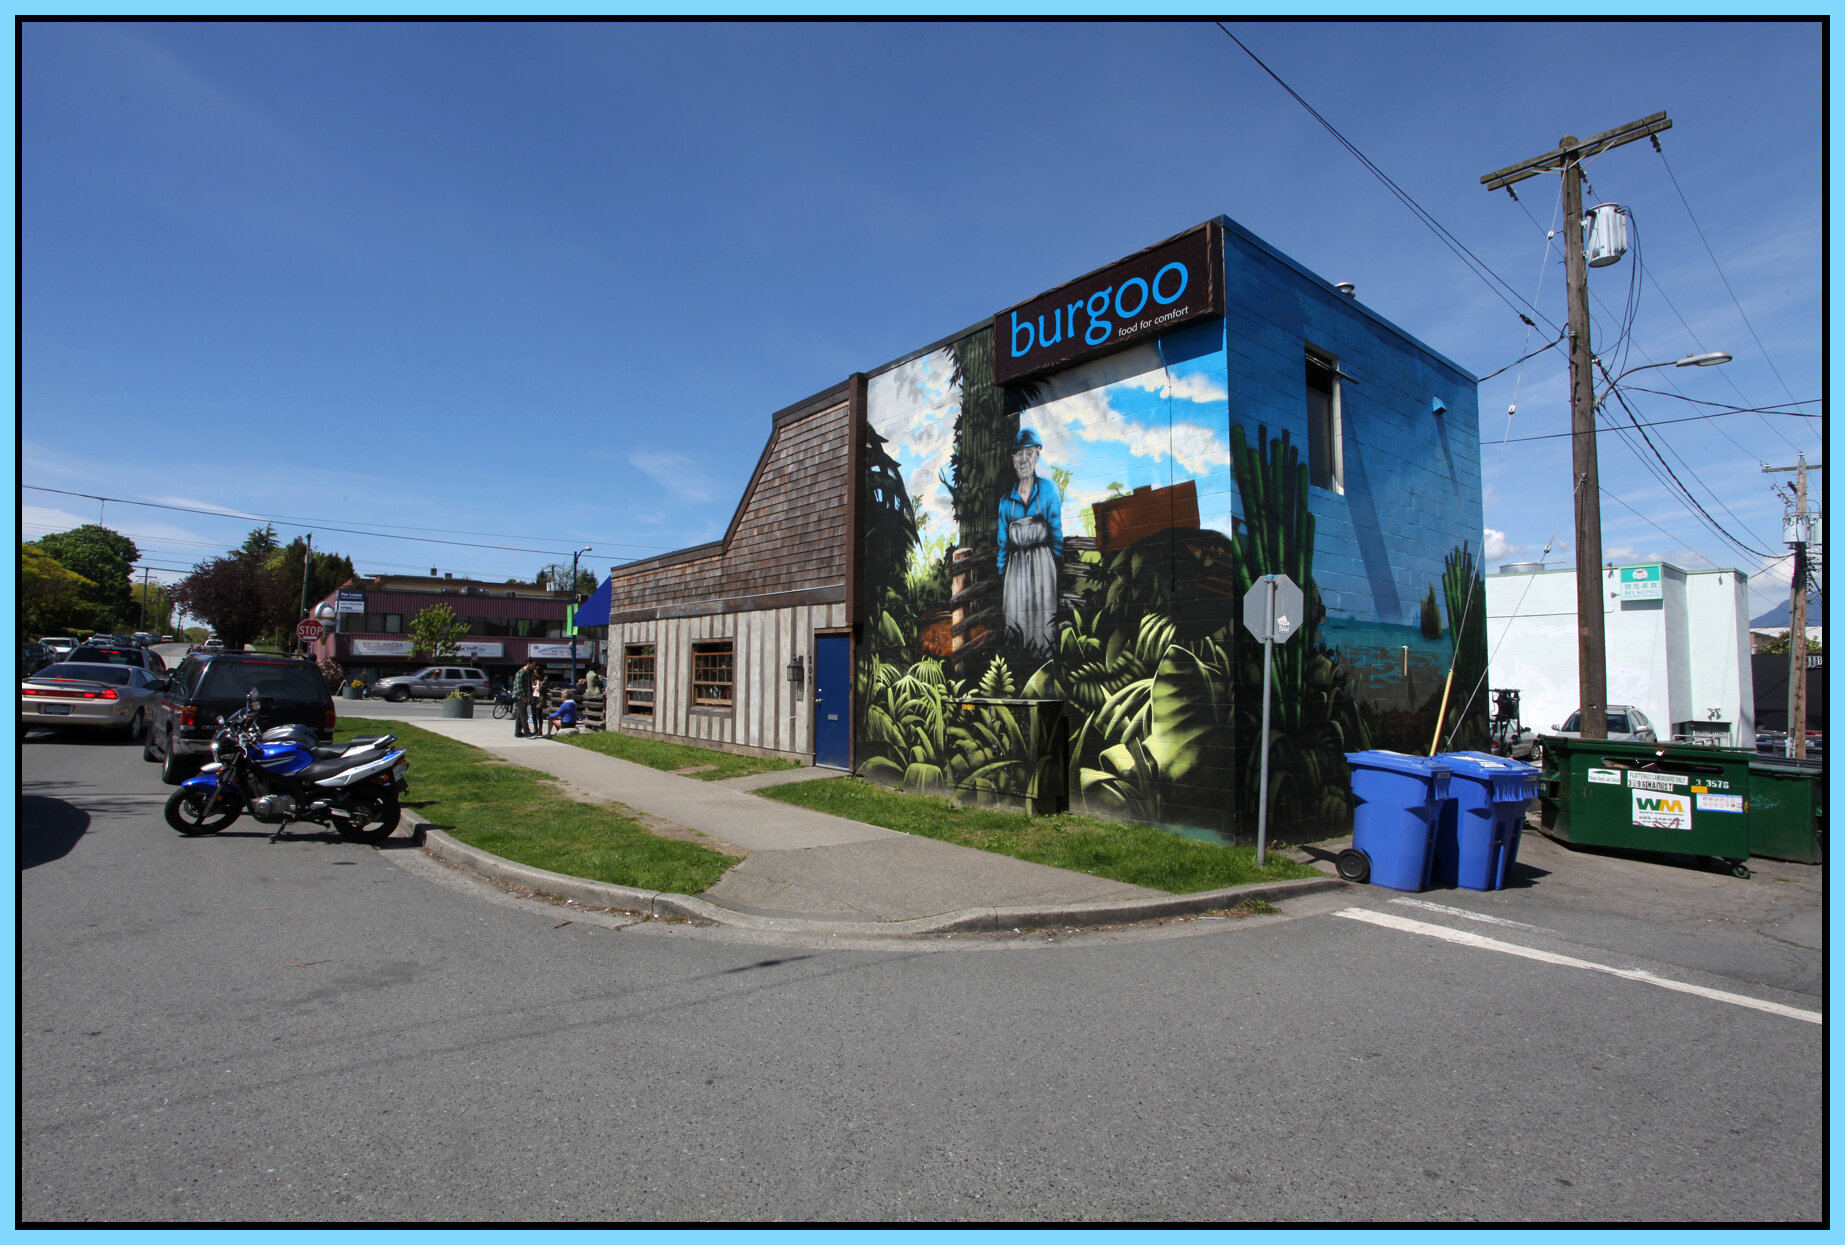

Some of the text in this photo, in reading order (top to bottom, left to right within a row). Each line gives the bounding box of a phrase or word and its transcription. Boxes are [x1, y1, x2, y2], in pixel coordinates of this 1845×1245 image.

[1011, 262, 1189, 358] burgoo
[1118, 306, 1189, 337] food for comfort
[298, 625, 323, 636] STOP
[1629, 772, 1651, 780] FLATTENED
[1651, 774, 1675, 783] CARDBOARD
[1636, 797, 1684, 813] WM
